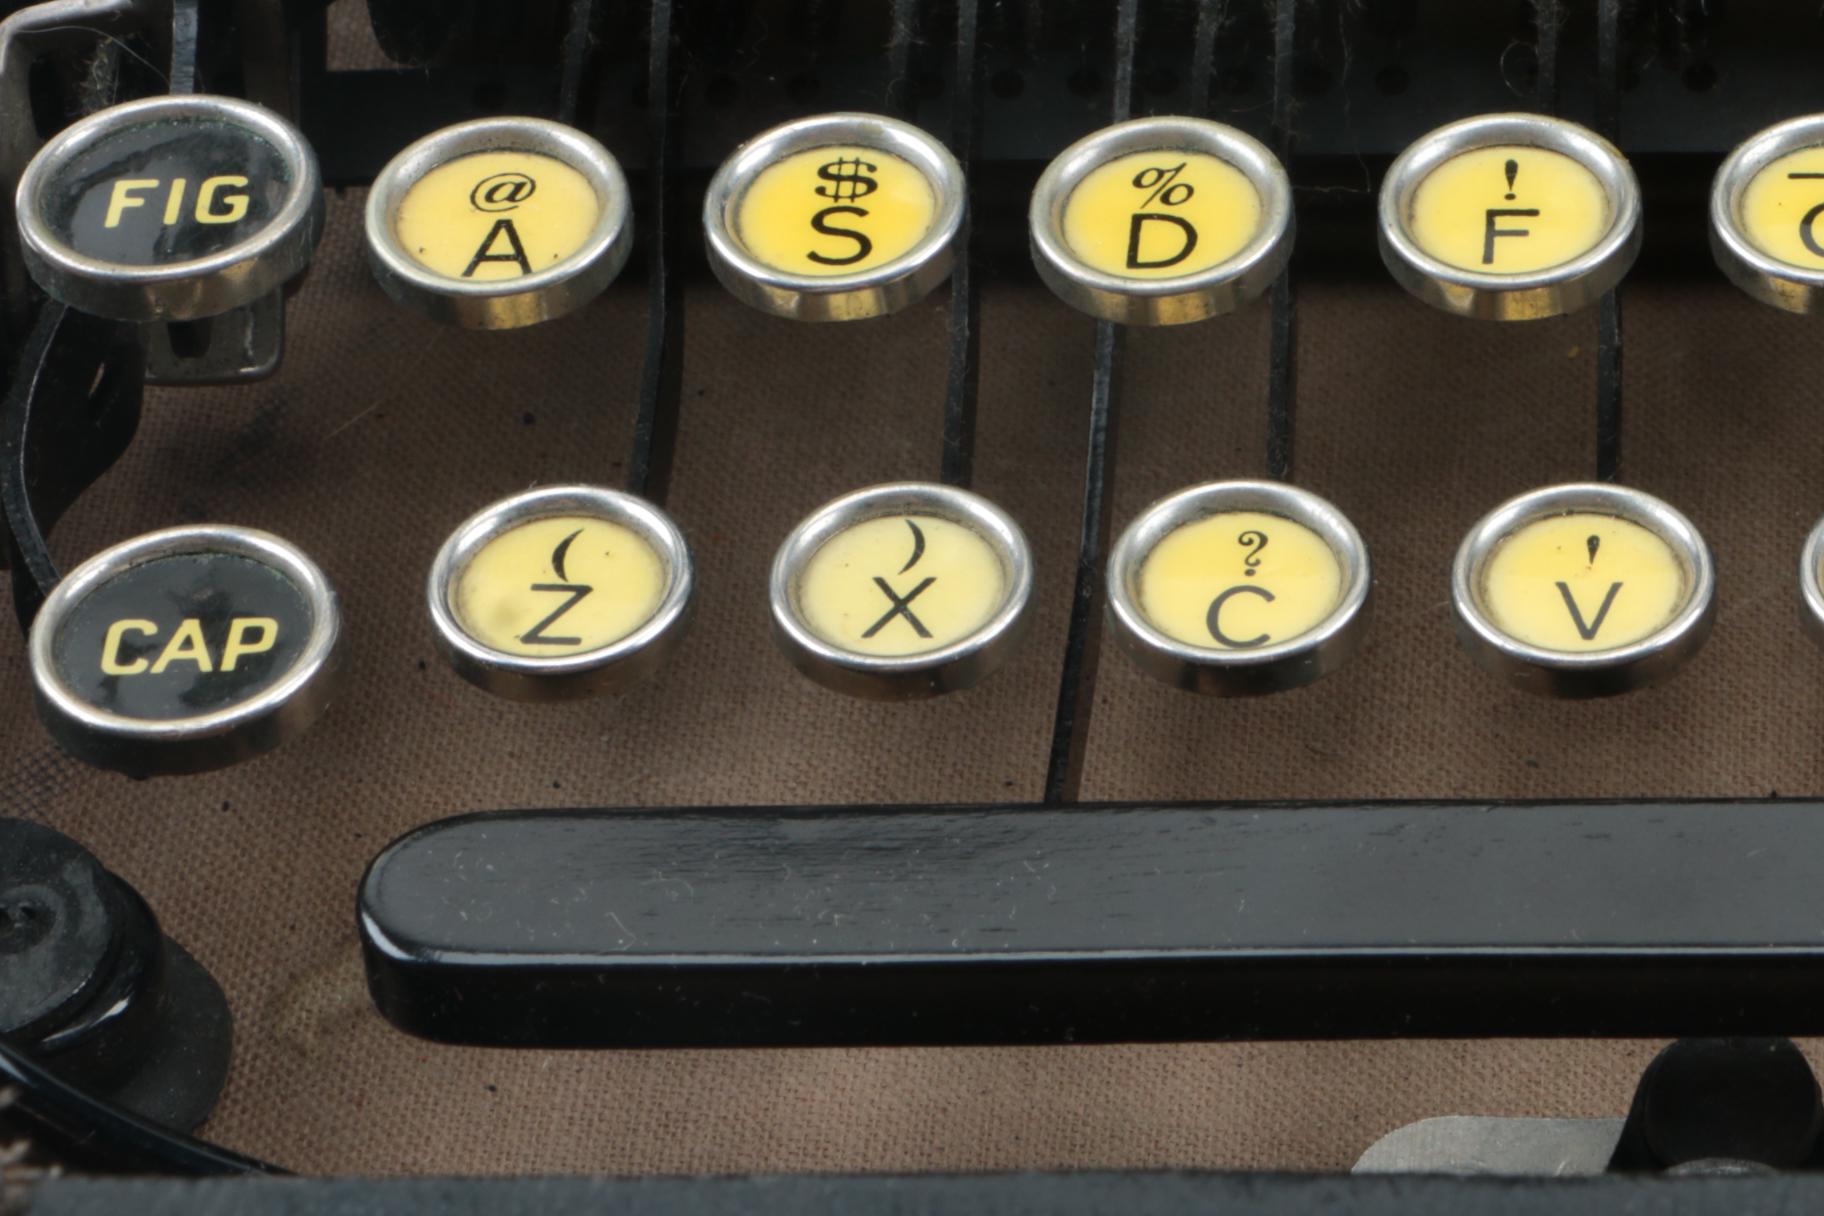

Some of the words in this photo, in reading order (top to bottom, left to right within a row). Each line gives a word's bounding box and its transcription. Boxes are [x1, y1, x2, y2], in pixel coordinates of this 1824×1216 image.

[104, 173, 250, 227] FIG
[470, 173, 536, 212] @
[815, 157, 878, 203] $
[1132, 163, 1194, 208] %
[1505, 159, 1518, 200] !
[461, 219, 534, 277] A
[807, 205, 872, 265] S
[1126, 213, 1198, 269] D
[1482, 208, 1540, 264] F
[552, 529, 583, 582] (
[900, 519, 925, 573] )
[1238, 531, 1268, 576] ?
[520, 584, 593, 645] Z
[862, 577, 936, 638] X
[1206, 585, 1275, 647] C
[1556, 582, 1622, 640] V
[100, 615, 279, 676] CAP
